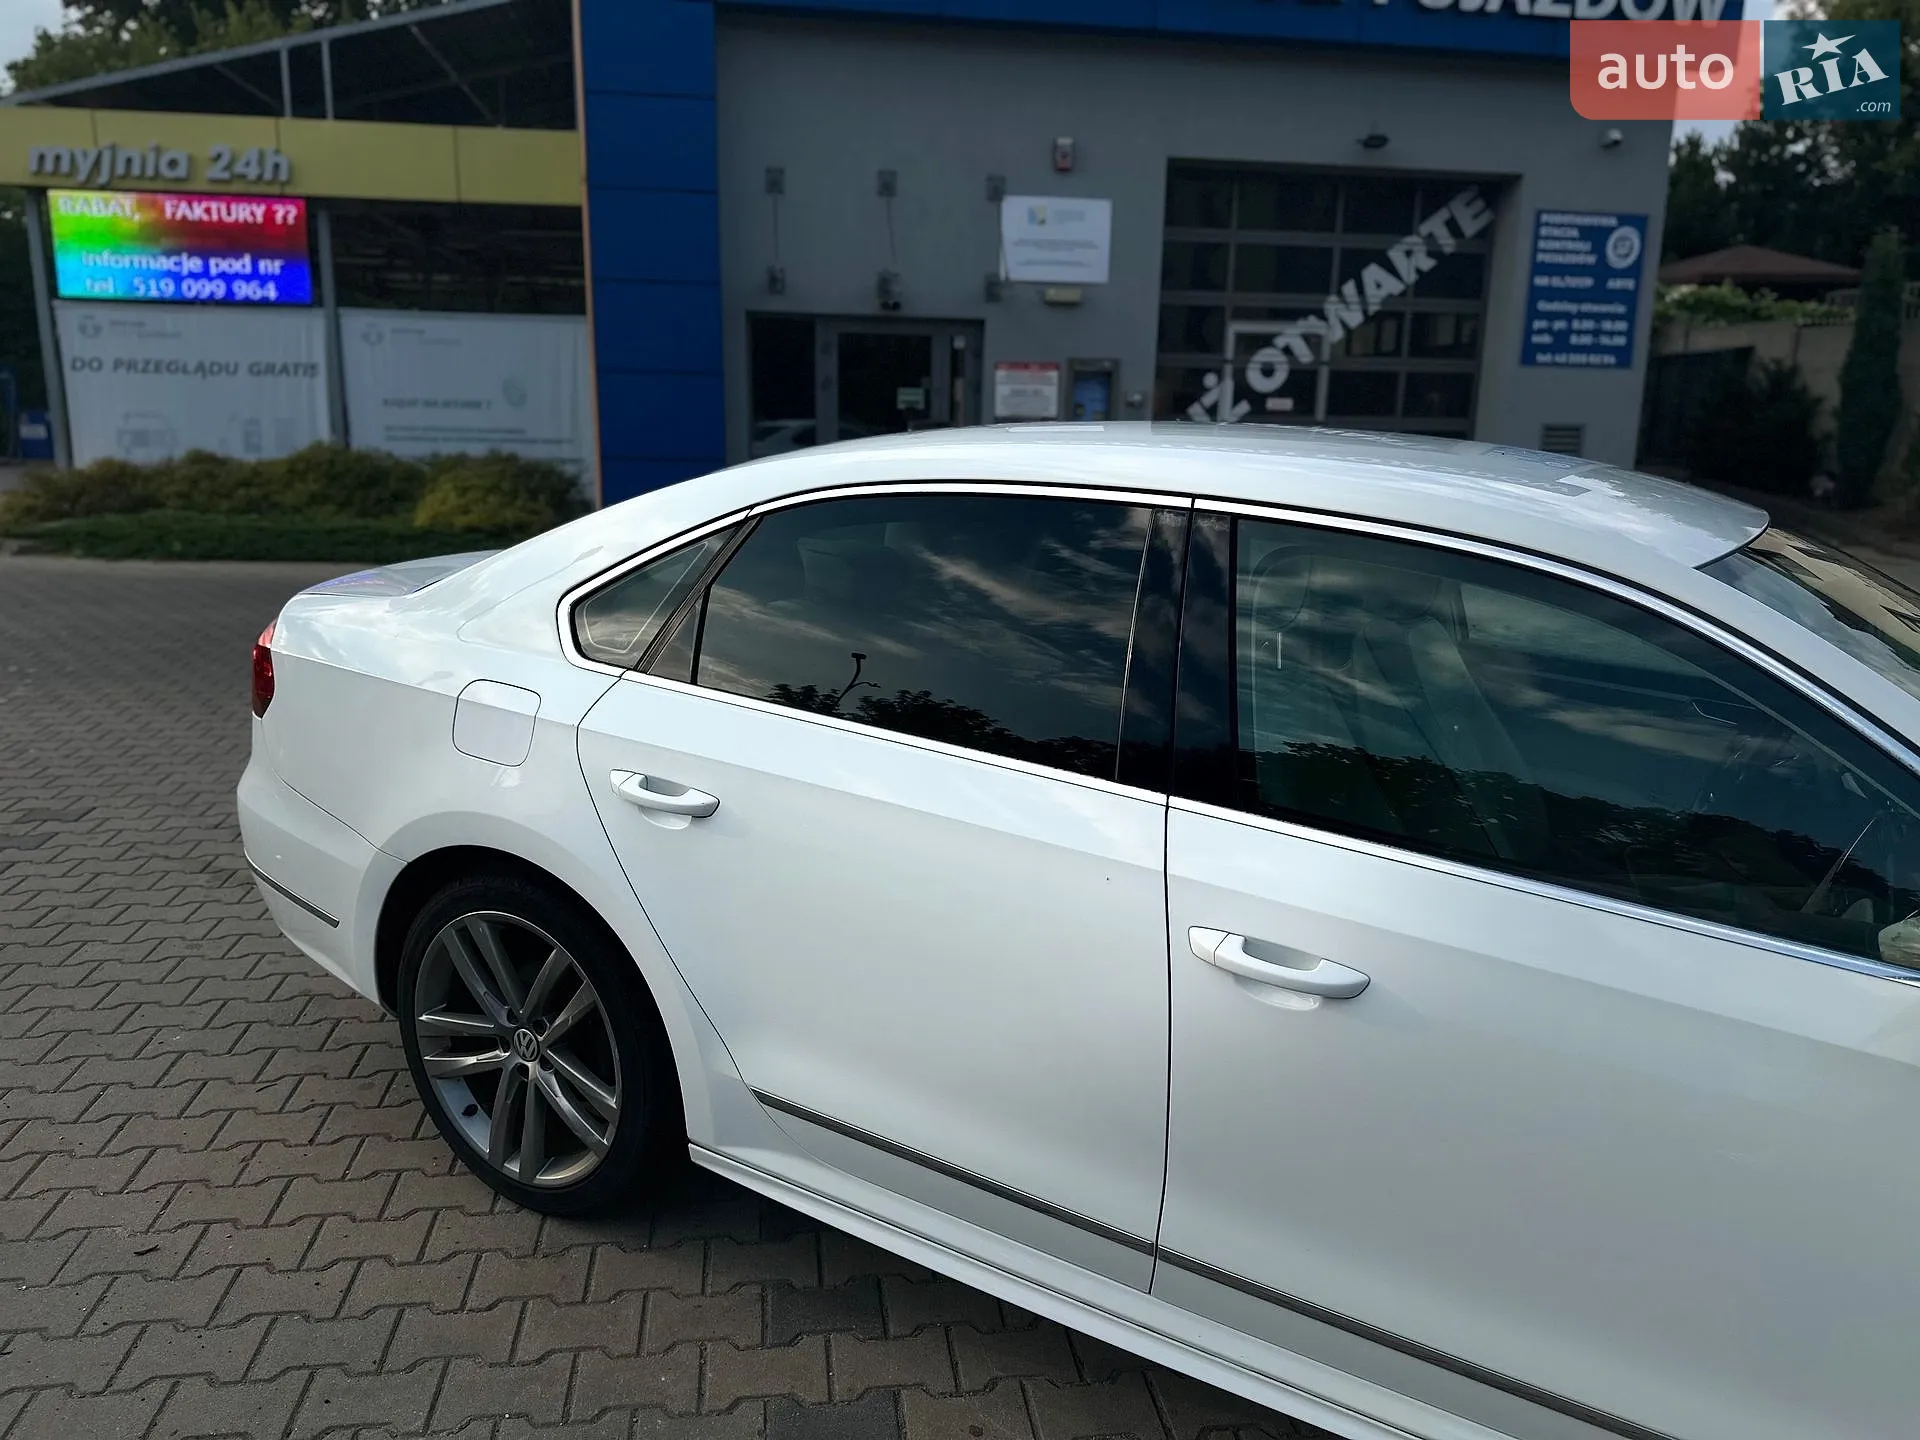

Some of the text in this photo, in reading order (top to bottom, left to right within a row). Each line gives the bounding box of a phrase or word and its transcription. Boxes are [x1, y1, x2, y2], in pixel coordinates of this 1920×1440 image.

[28, 140, 290, 186] myjnia 24h
[57, 197, 299, 225] RABAT, FAKTURY ??
[208, 254, 252, 276] pod
[258, 258, 285, 275] nr
[133, 278, 174, 298] 519
[181, 278, 227, 299] 099
[232, 280, 278, 301] 964
[1245, 184, 1495, 393] OTWARTE
[71, 356, 104, 373] DO
[112, 357, 240, 380] PRZEGLĄDU
